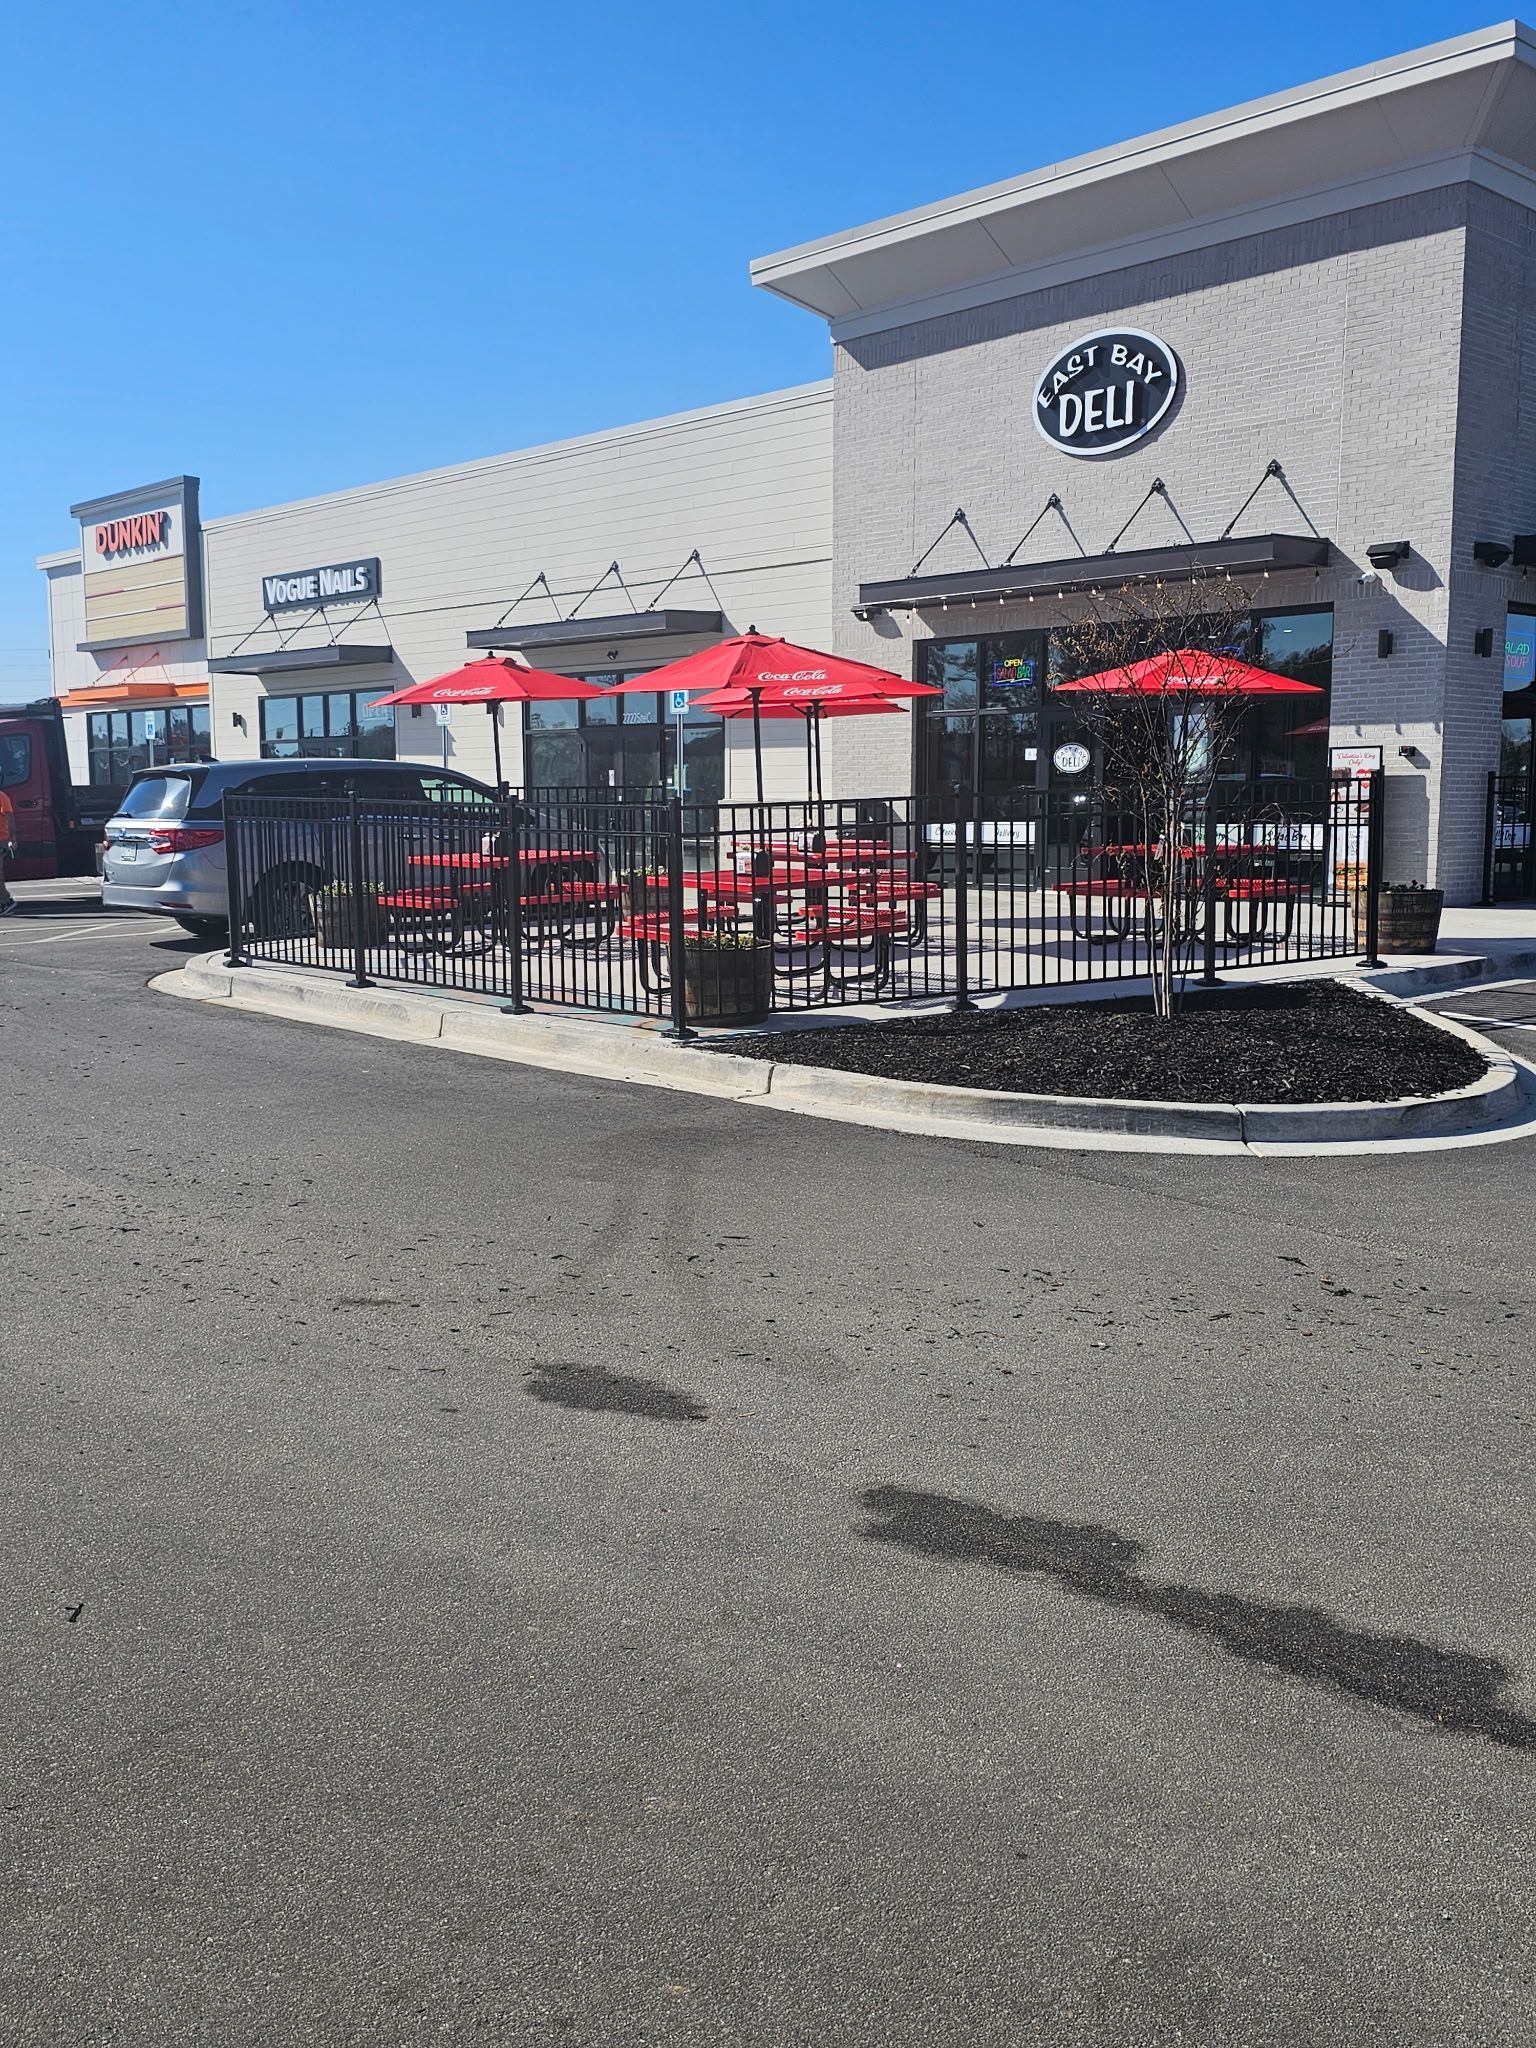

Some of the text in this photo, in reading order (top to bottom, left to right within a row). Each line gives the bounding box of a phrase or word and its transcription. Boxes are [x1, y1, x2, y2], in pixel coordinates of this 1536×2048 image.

[1038, 344, 1163, 408] EAST BAY
[1059, 380, 1135, 437] DELI
[96, 511, 163, 554] DUNKIN'
[264, 566, 368, 604] VOGUE NAILS
[1505, 641, 1530, 656] ALAD
[1003, 658, 1024, 668] OPEN
[757, 669, 827, 682] Coca-Cola
[1016, 665, 1031, 679] BAR
[432, 686, 498, 698] Coca-Cola
[783, 684, 846, 697] Coca-Cola
[1062, 757, 1080, 768] DELI
